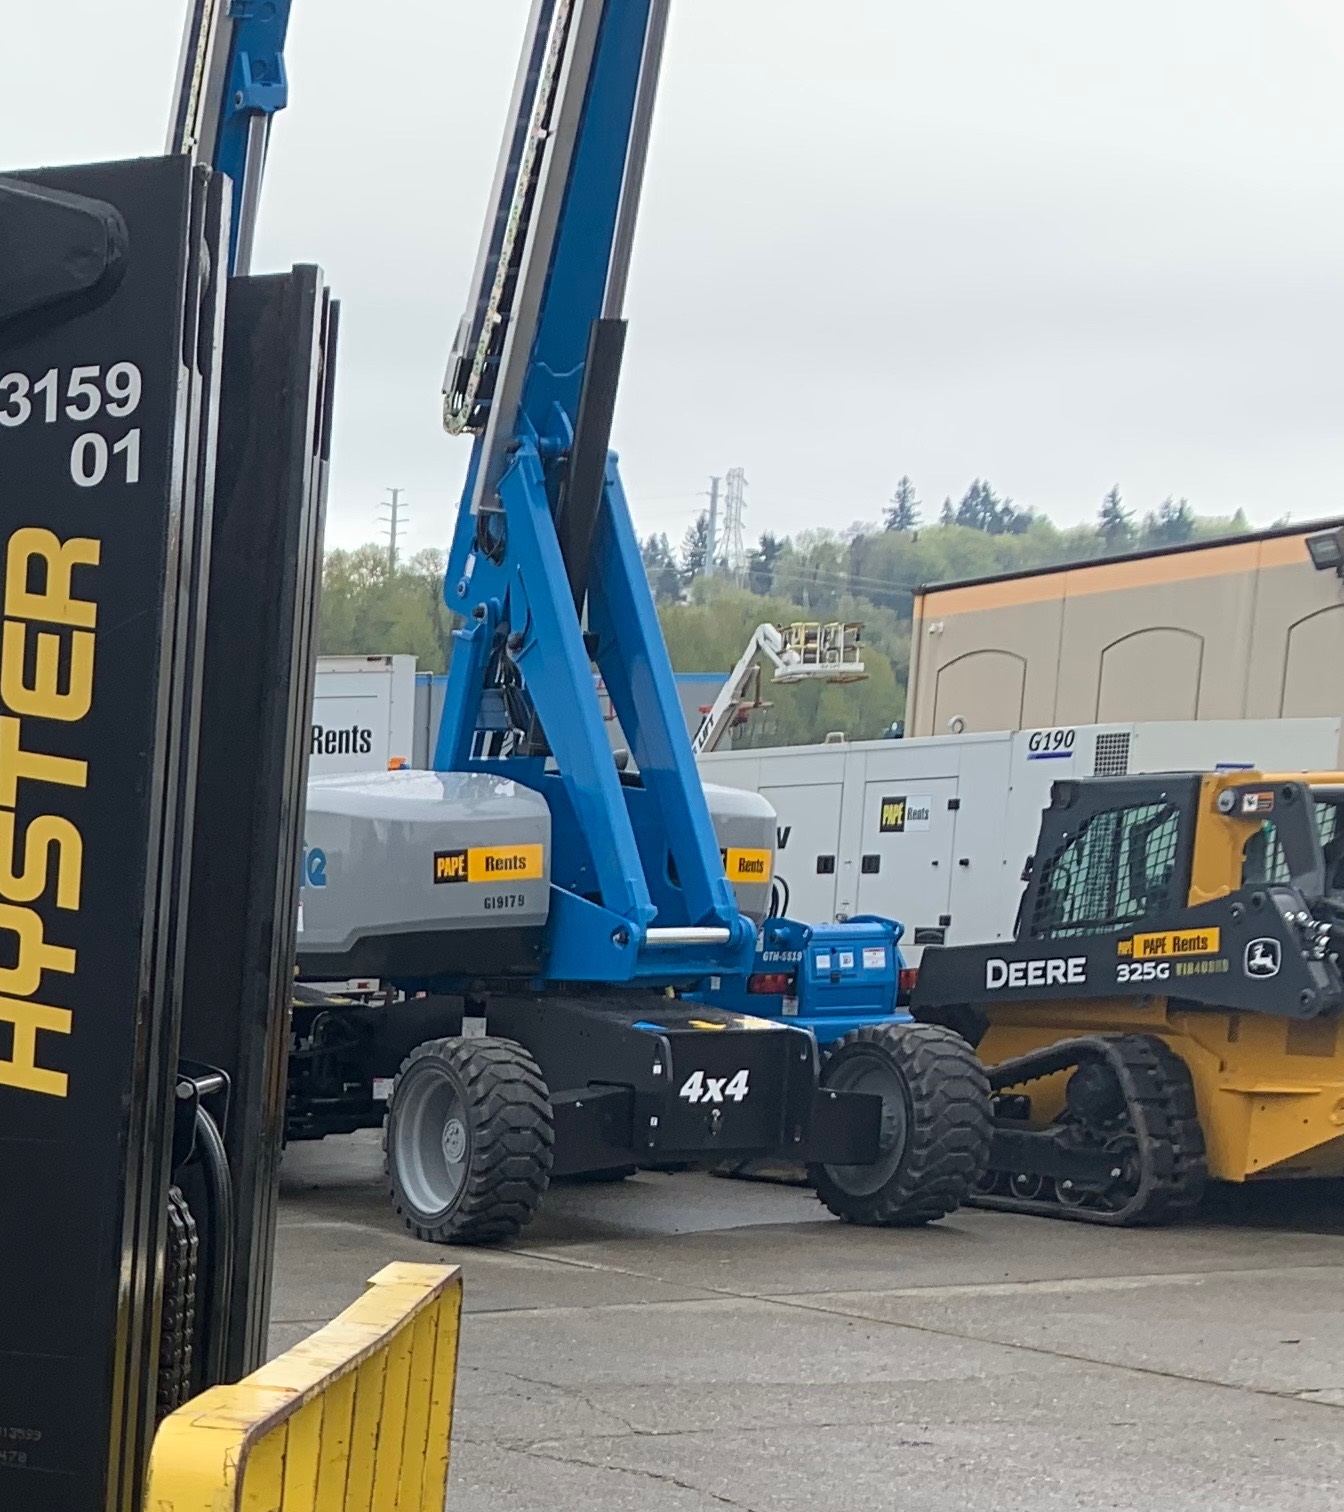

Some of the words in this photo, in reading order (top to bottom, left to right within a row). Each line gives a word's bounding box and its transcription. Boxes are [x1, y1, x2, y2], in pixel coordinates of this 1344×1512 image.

[70, 428, 141, 488] 01
[310, 725, 372, 755] Rents
[1028, 729, 1076, 752] G190
[906, 806, 930, 821] Rents
[485, 855, 527, 872] Rents
[738, 857, 764, 873] Rents
[484, 894, 525, 910] G19179
[1172, 935, 1209, 953] Rents
[985, 956, 1087, 990] DEERE
[1116, 962, 1170, 983] 325G
[678, 1069, 750, 1104] 4x4
